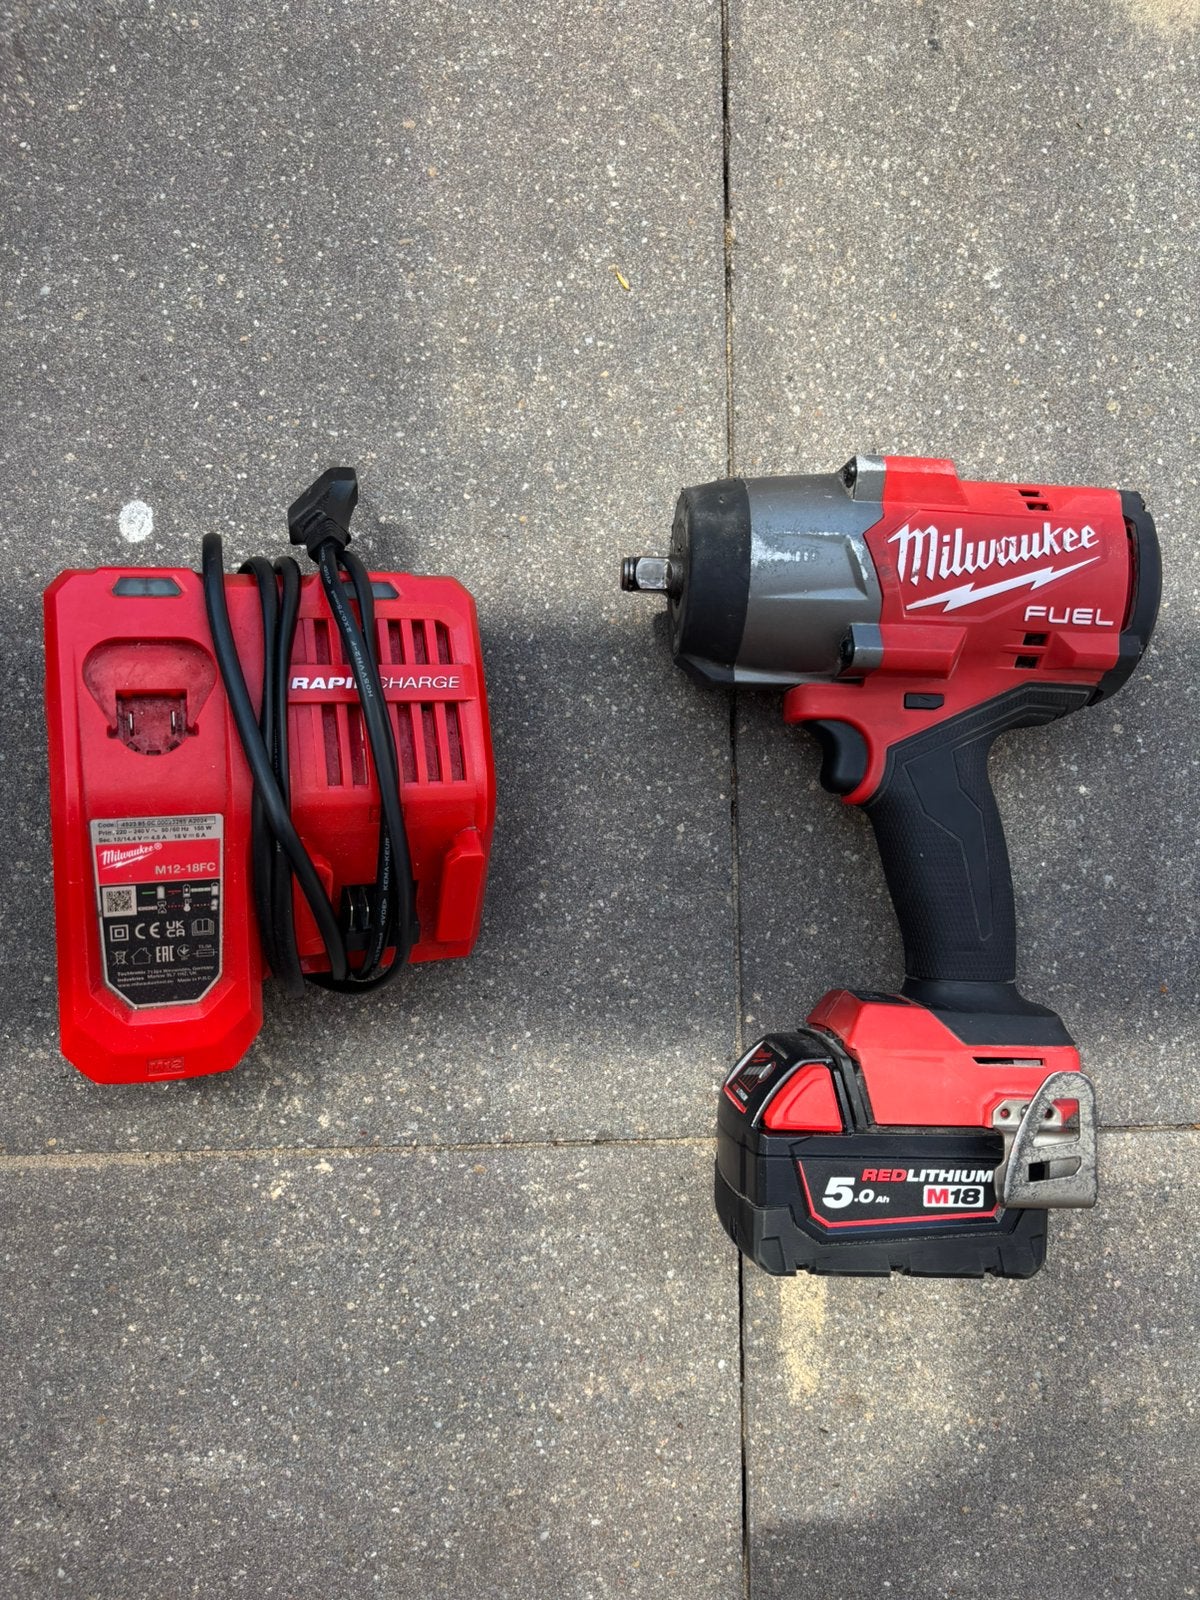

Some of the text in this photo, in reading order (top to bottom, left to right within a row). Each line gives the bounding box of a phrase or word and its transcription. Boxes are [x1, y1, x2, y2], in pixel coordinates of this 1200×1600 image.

[887, 522, 1100, 587] Milwaukee
[1023, 605, 1114, 626] FUEL
[291, 676, 357, 690] RAPI
[155, 862, 217, 875] M12-18FC
[861, 1168, 994, 1184] REDLITHIUM
[875, 1195, 890, 1204] Ah
[926, 1187, 981, 1205] M18
